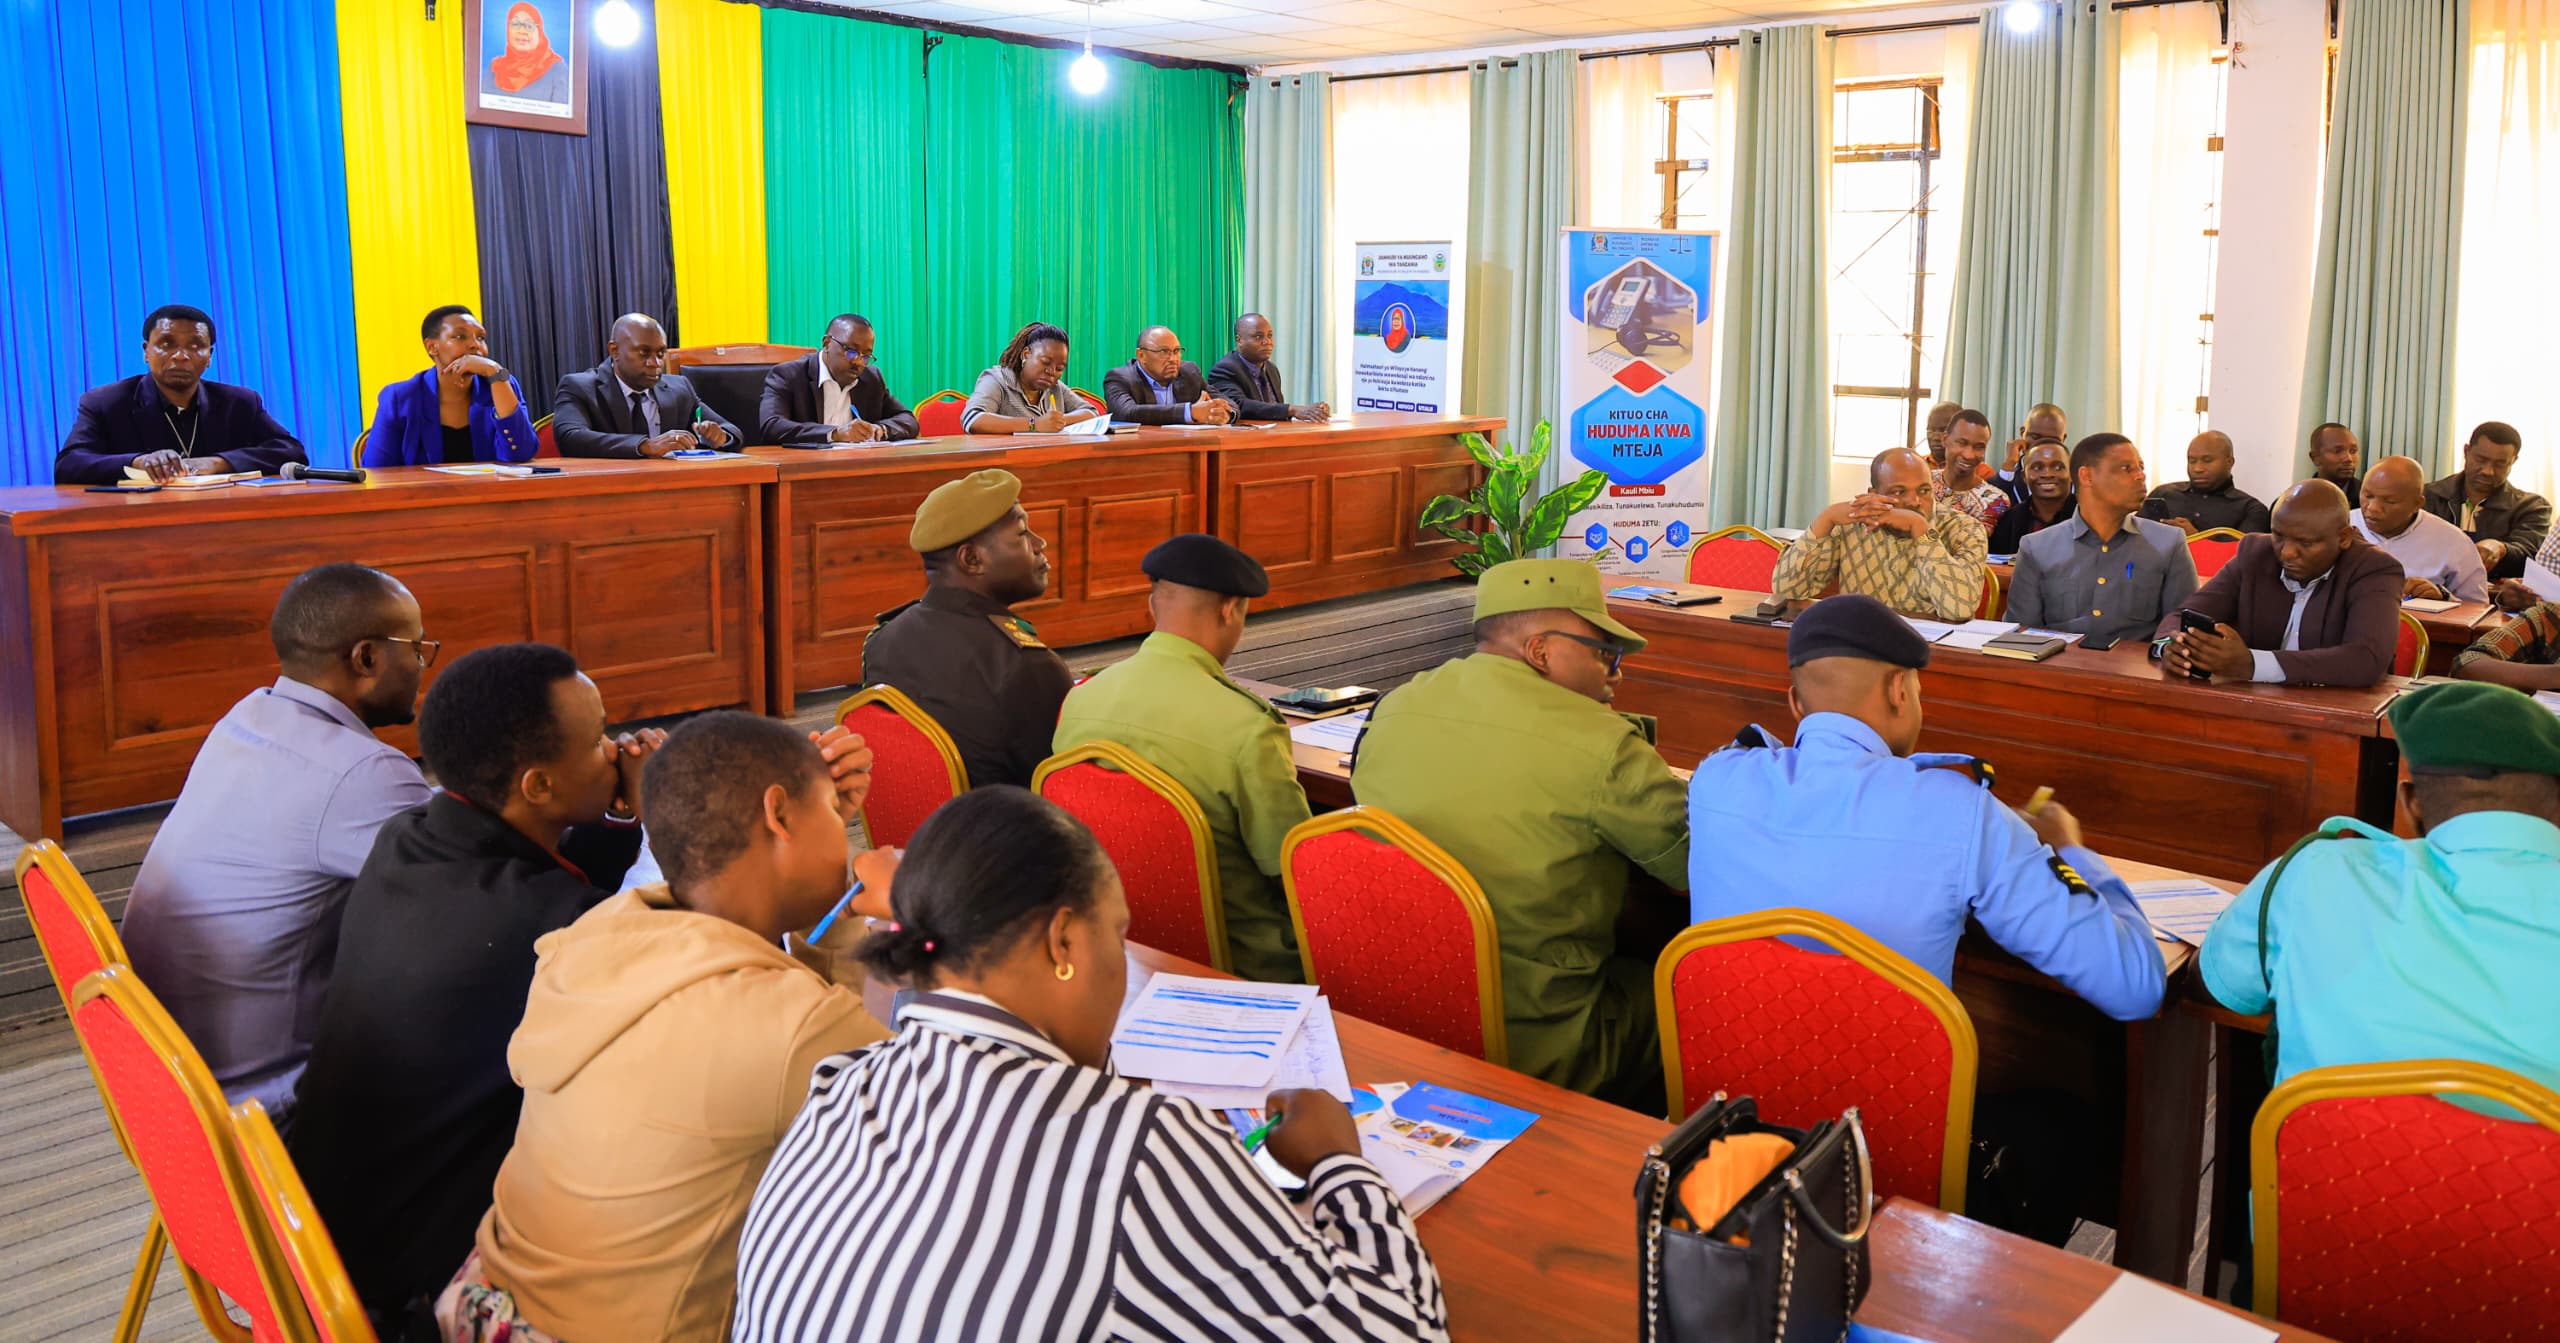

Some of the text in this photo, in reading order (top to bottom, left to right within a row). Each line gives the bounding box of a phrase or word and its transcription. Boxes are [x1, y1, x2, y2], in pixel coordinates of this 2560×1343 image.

[1609, 410, 1668, 420] KITUO CHA
[1587, 424, 1691, 439] HUDUMA KWA
[1613, 443, 1663, 457] MTEJA
